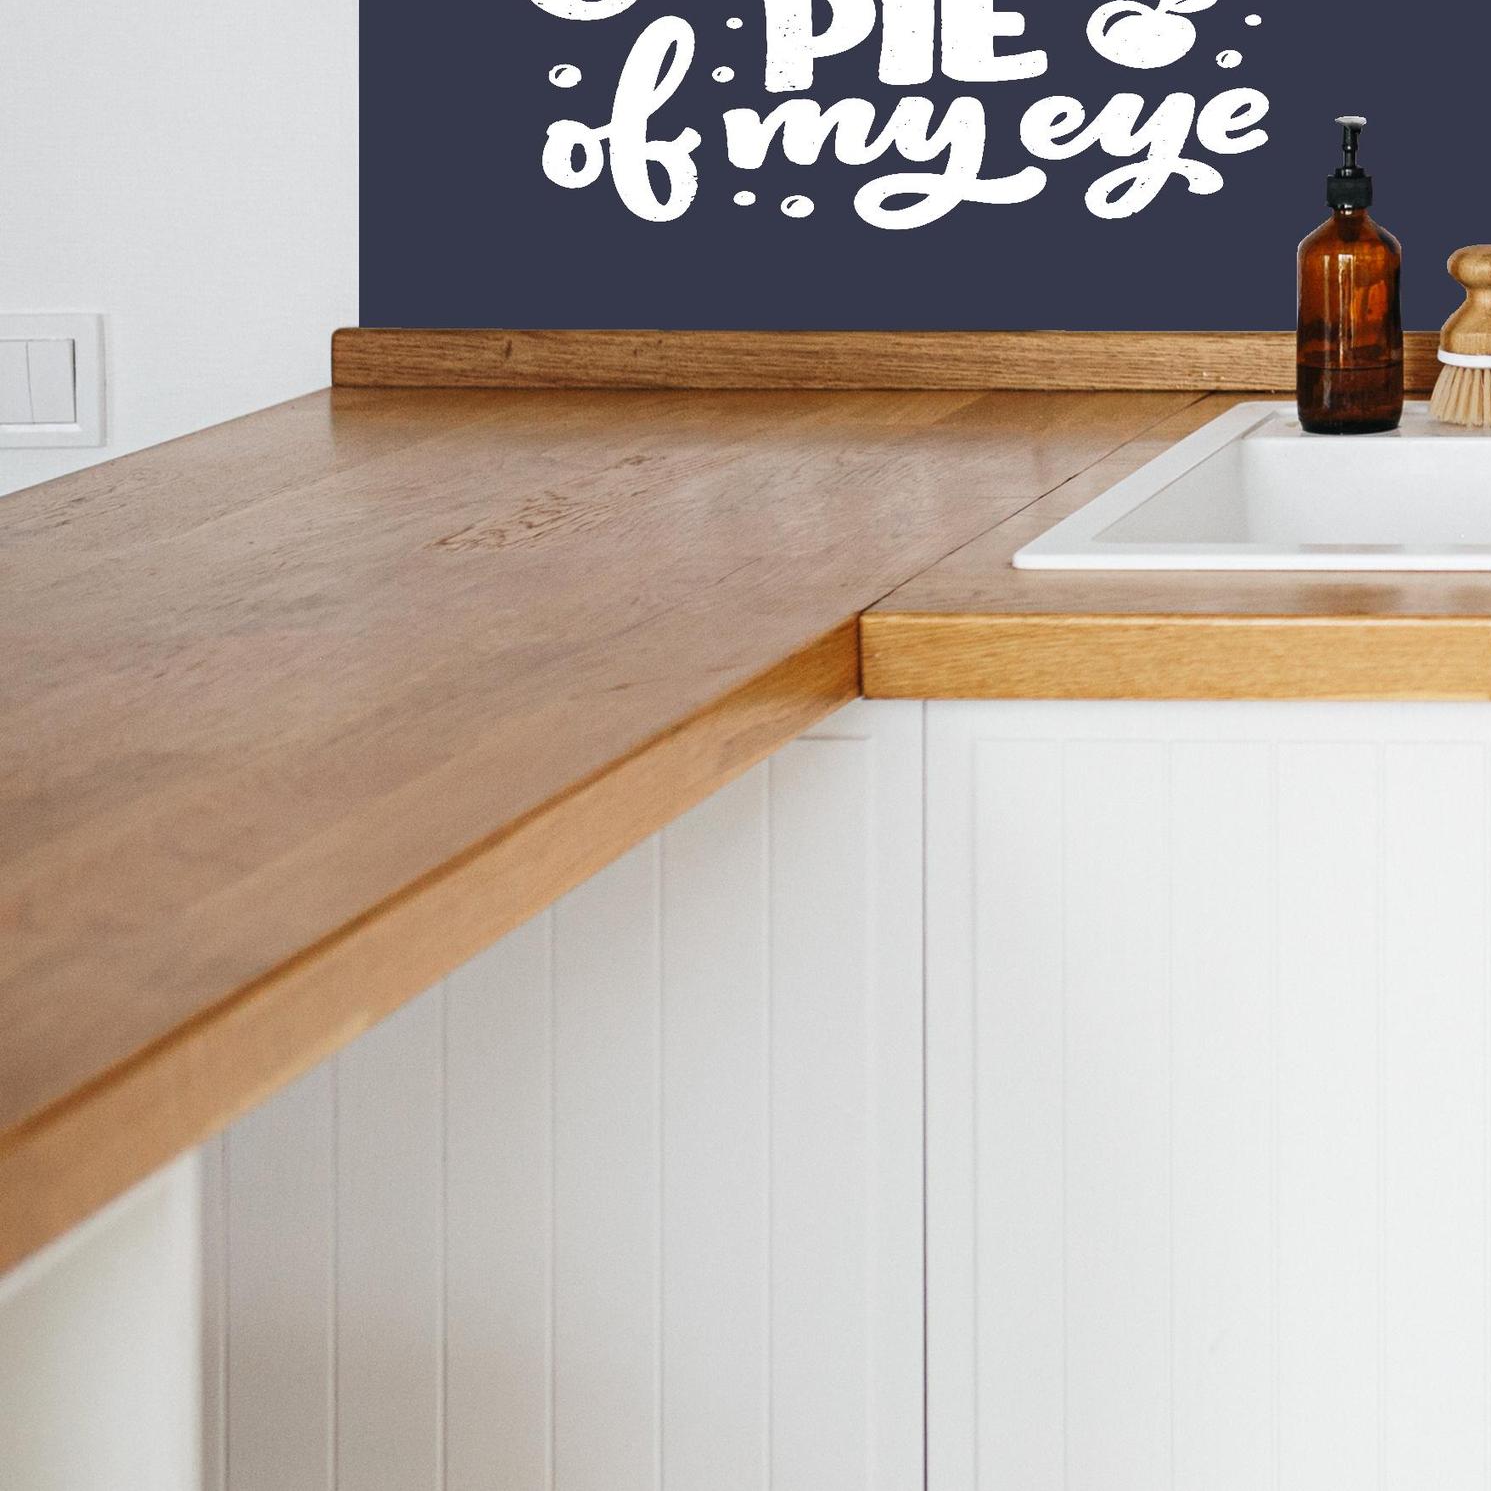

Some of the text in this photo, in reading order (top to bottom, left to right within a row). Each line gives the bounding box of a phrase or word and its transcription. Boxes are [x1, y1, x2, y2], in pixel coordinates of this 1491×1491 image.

[543, 16, 1270, 230] of my eye
